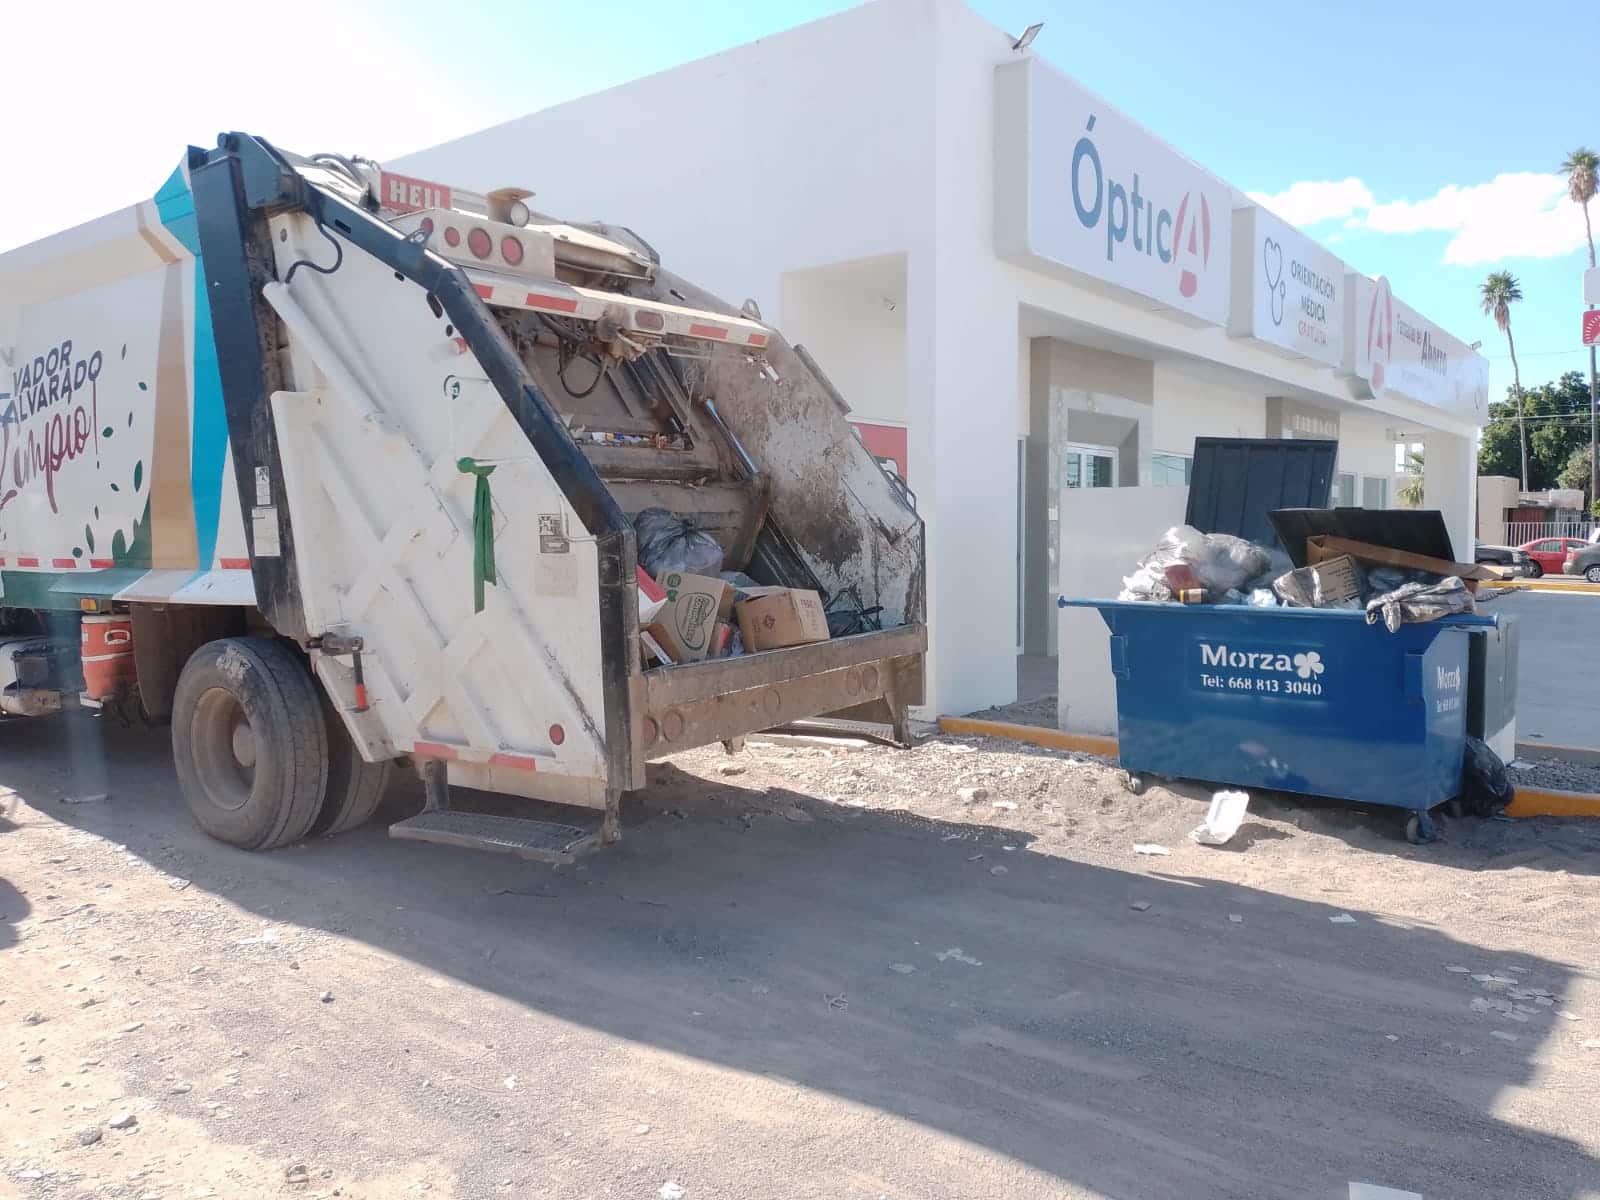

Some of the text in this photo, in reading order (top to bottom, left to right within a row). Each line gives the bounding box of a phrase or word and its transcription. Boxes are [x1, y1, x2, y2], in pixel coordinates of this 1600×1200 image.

[1200, 644, 1293, 671] Morza
[1200, 674, 1322, 695] Tel: 668 813 3040
